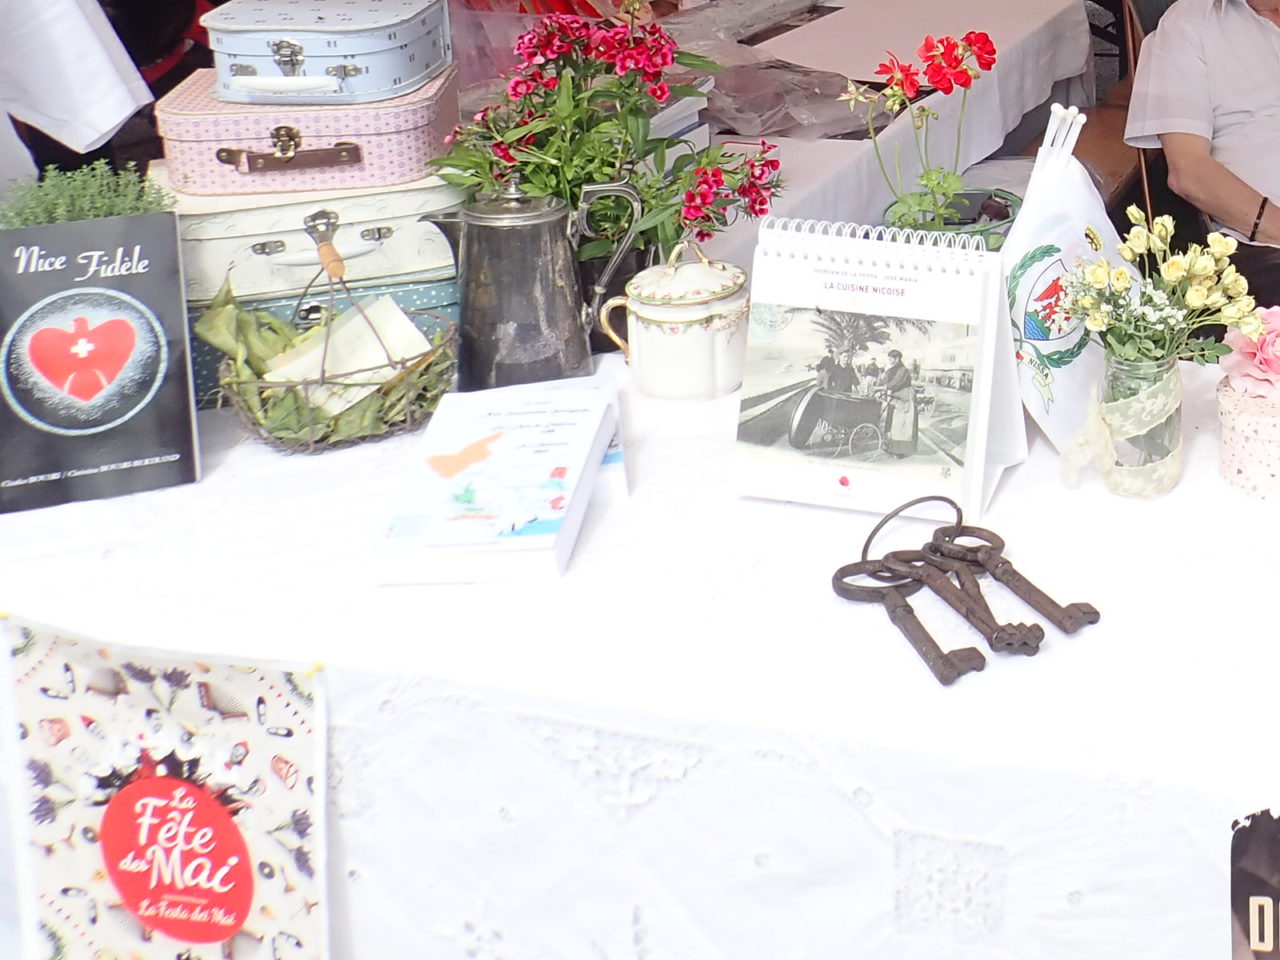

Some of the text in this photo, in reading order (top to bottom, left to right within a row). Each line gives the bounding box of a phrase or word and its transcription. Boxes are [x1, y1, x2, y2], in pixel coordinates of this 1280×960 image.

[13, 244, 150, 282] Nice Fidèle
[824, 281, 834, 289] LA
[837, 283, 870, 294] CUISINE
[1028, 357, 1049, 380] NISSA
[168, 786, 198, 809] La
[134, 796, 218, 854] Fête
[145, 843, 240, 893] Mai
